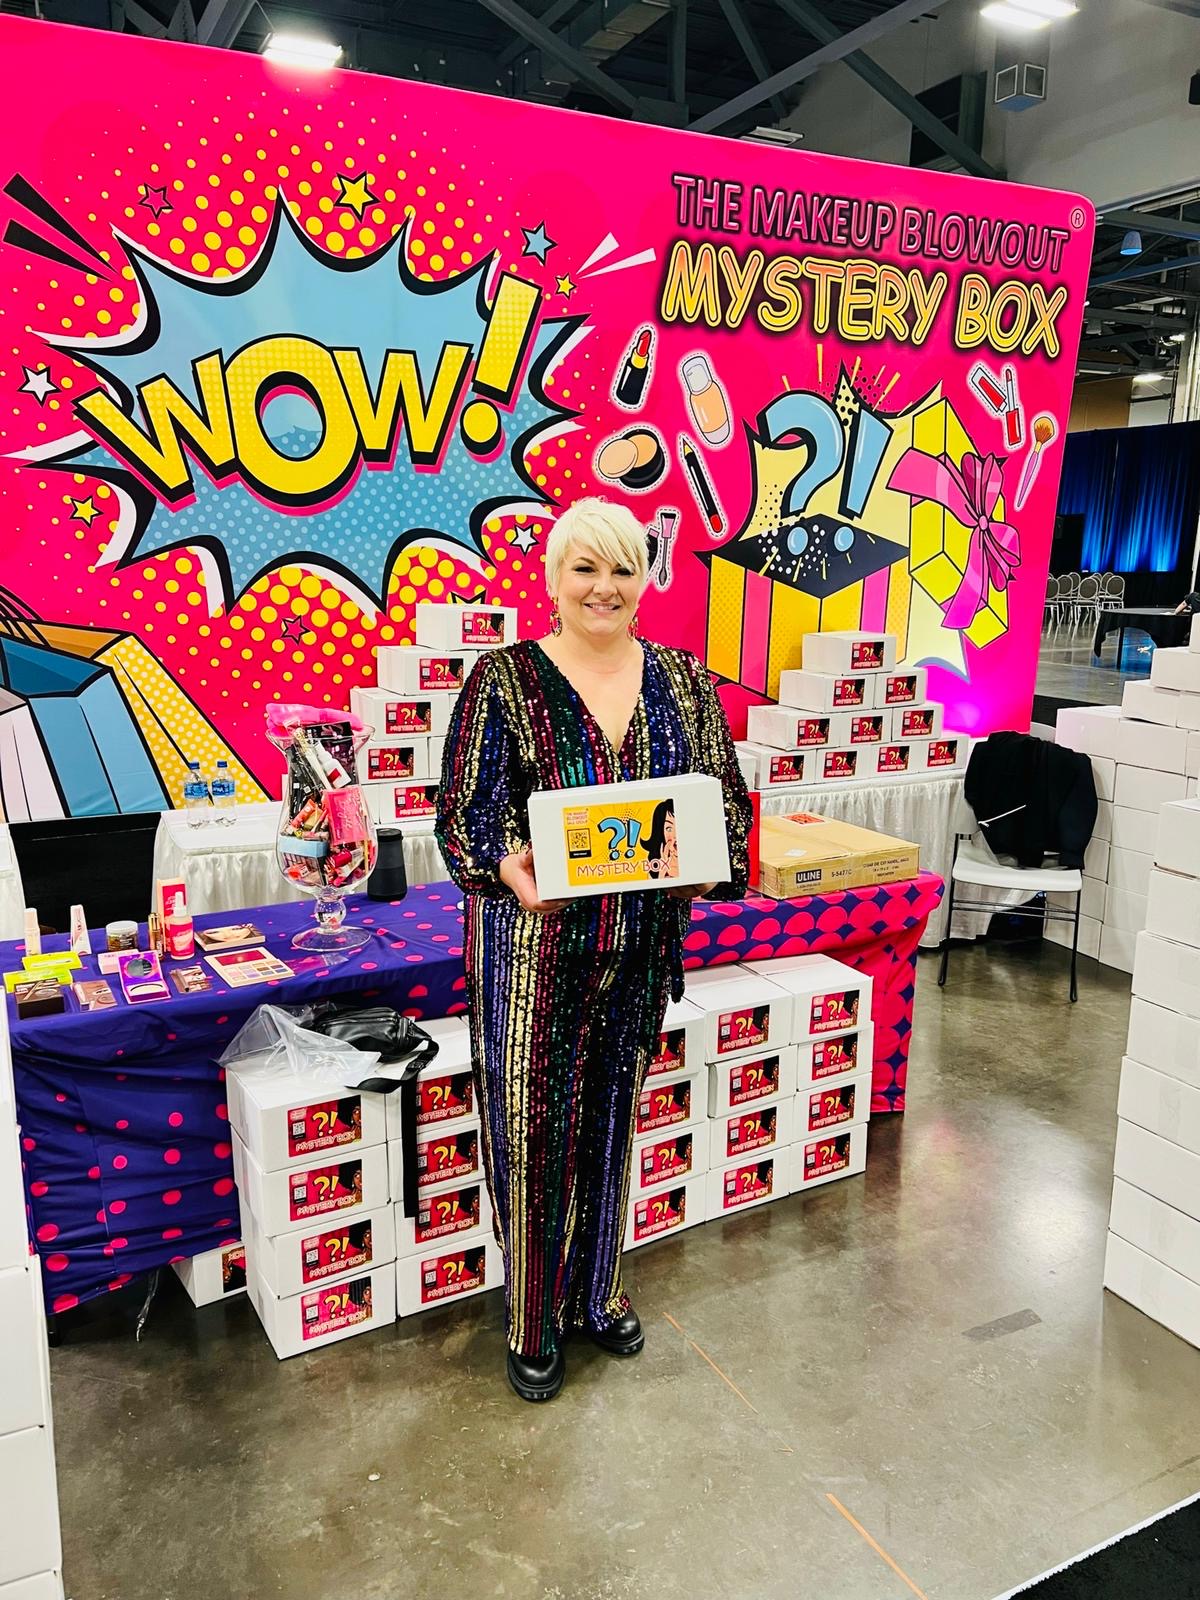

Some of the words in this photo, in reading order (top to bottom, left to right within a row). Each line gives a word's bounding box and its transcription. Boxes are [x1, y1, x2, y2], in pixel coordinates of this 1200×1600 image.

[673, 174, 742, 231] THE
[751, 187, 897, 250] MAKEUP
[901, 208, 1069, 272] BLOWOUT
[661, 240, 948, 345] MYSTERY
[955, 273, 1068, 359] BOX
[76, 272, 544, 504] WOW!
[577, 862, 640, 877] MYSTERY
[642, 858, 671, 872] BOX
[797, 870, 820, 882] ULINE
